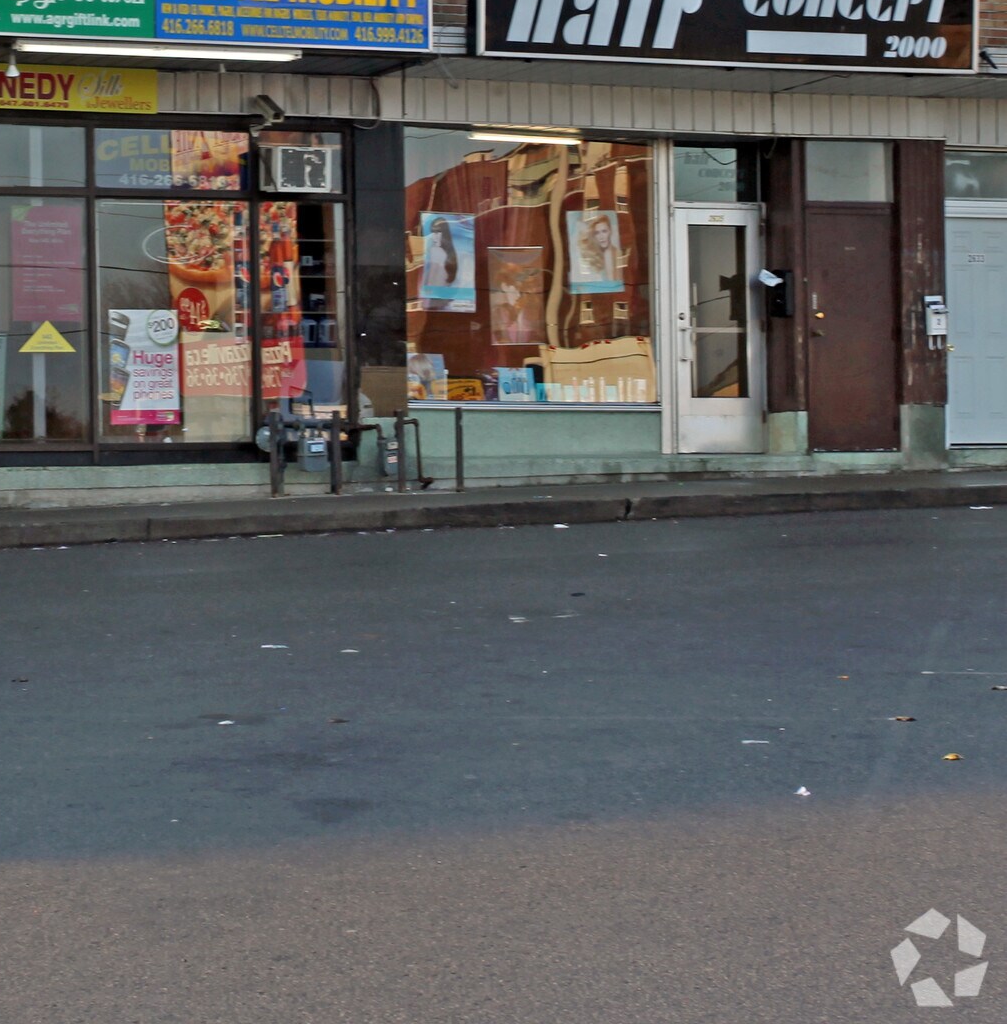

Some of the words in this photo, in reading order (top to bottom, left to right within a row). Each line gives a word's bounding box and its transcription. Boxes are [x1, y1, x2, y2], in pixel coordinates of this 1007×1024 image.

[883, 35, 947, 58] 2000
[92, 97, 152, 112] Jewellers
[97, 134, 172, 161] CELL
[148, 317, 175, 333] $200
[133, 350, 173, 367] Huge
[133, 367, 173, 380] savings
[133, 380, 144, 388] on
[146, 379, 173, 390] great
[133, 389, 174, 402] phones
